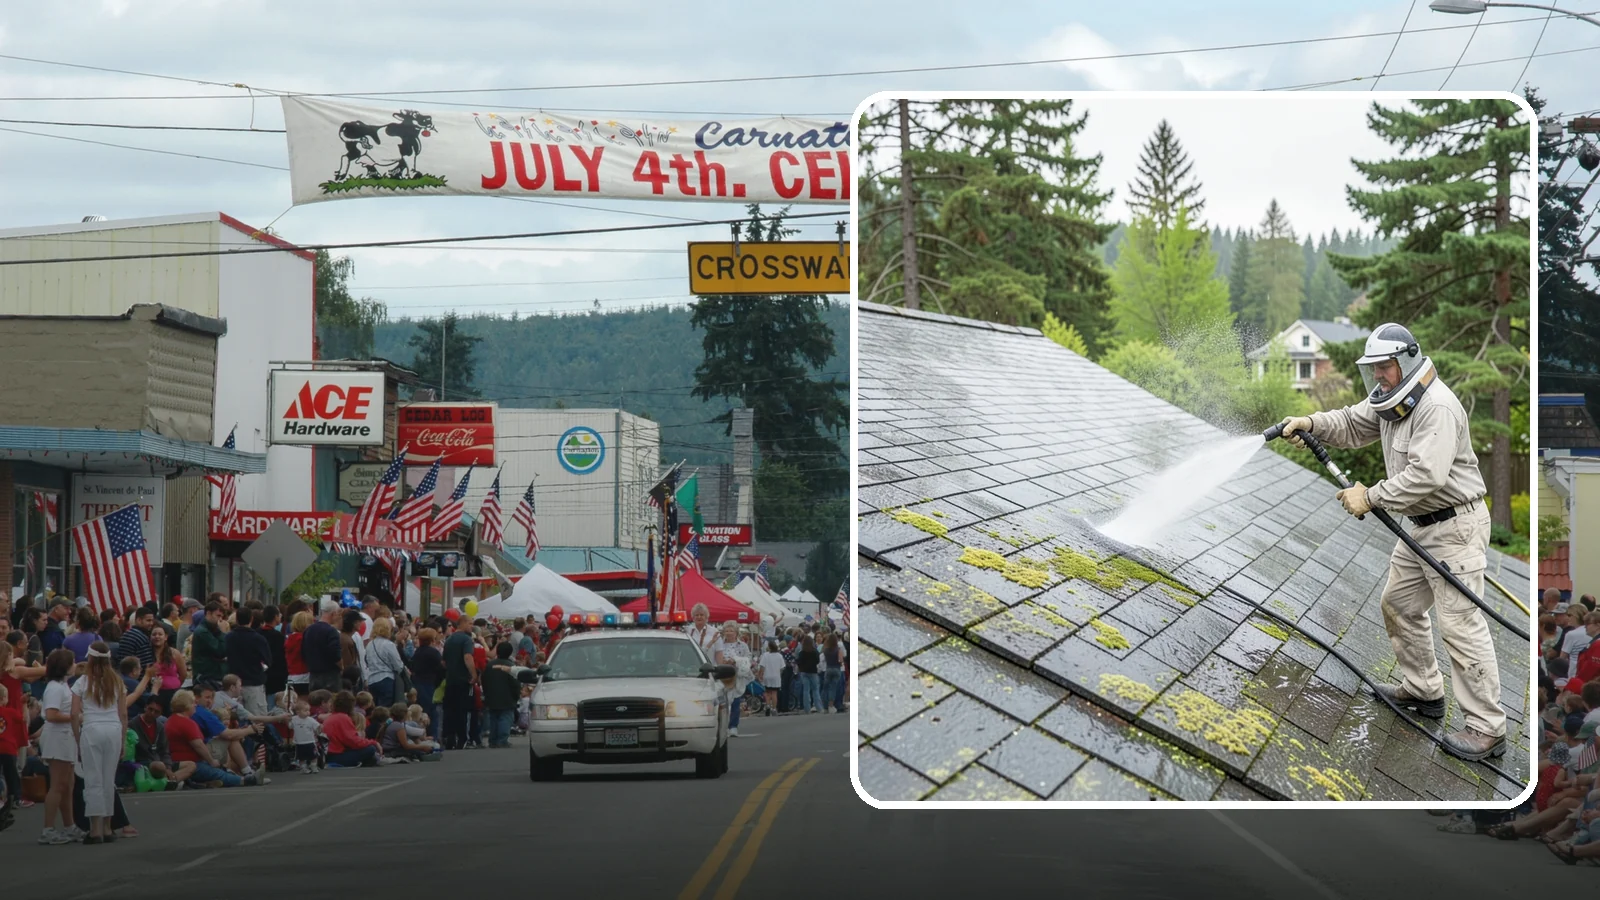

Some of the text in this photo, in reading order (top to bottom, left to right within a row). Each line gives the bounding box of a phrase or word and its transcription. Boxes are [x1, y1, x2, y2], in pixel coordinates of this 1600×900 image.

[481, 141, 603, 192] JULY
[633, 150, 746, 197] 4th.
[697, 254, 850, 279] CROSSWA
[283, 380, 373, 419] ACE
[405, 410, 485, 421] CEDAR LOG
[284, 421, 371, 436] Hardware
[416, 428, 477, 447] Coca-Cola
[83, 485, 155, 495] St. Vincent de Paul
[688, 526, 741, 535] CRNATION
[699, 535, 730, 543] GLASS
